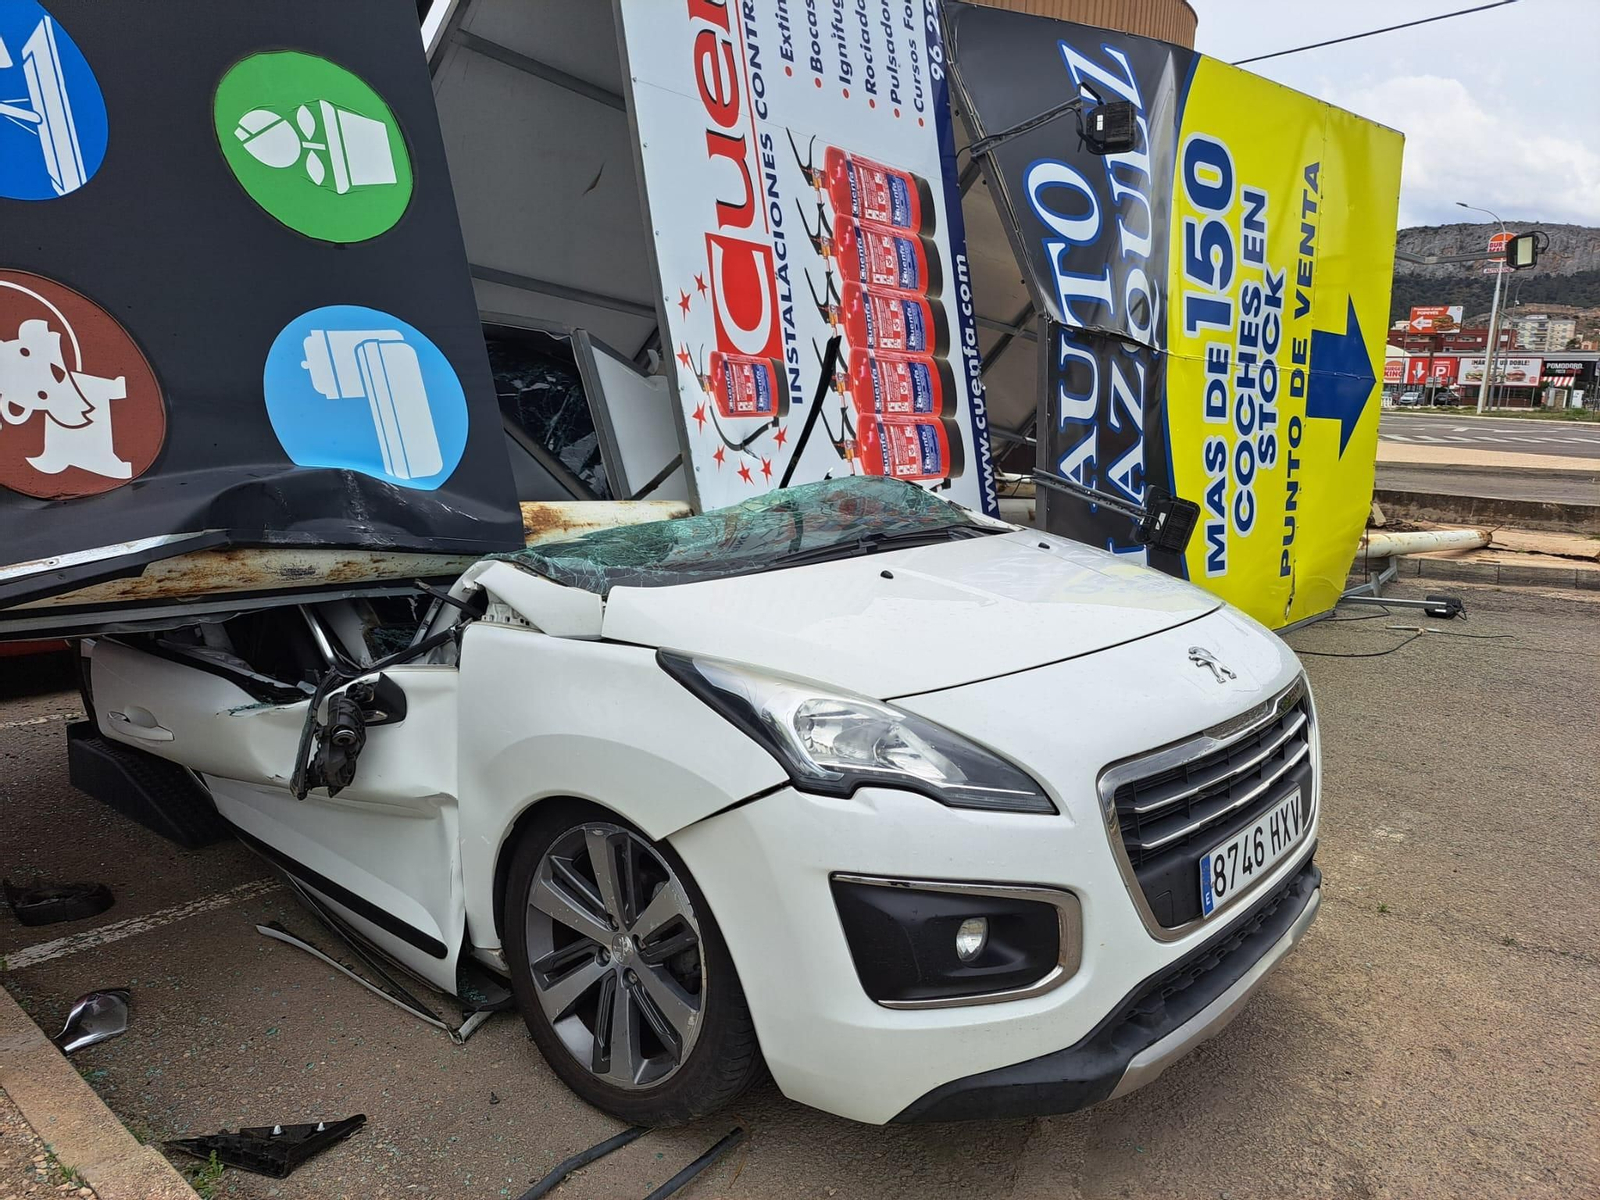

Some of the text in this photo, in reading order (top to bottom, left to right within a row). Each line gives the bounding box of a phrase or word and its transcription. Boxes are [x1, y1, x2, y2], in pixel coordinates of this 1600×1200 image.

[743, 0, 803, 404] INSTALACIONES CONTR
[908, 38, 925, 113] Cursos
[956, 253, 998, 512] www.cuenfa.com
[1025, 158, 1116, 511] AUTO
[1182, 135, 1235, 573] MAS DE 150
[1233, 188, 1267, 534] COCHES EN
[1257, 266, 1285, 466] STOCK
[1280, 161, 1320, 577] PUNTO DE VENTA
[1205, 795, 1299, 905] E 8746 HXV
